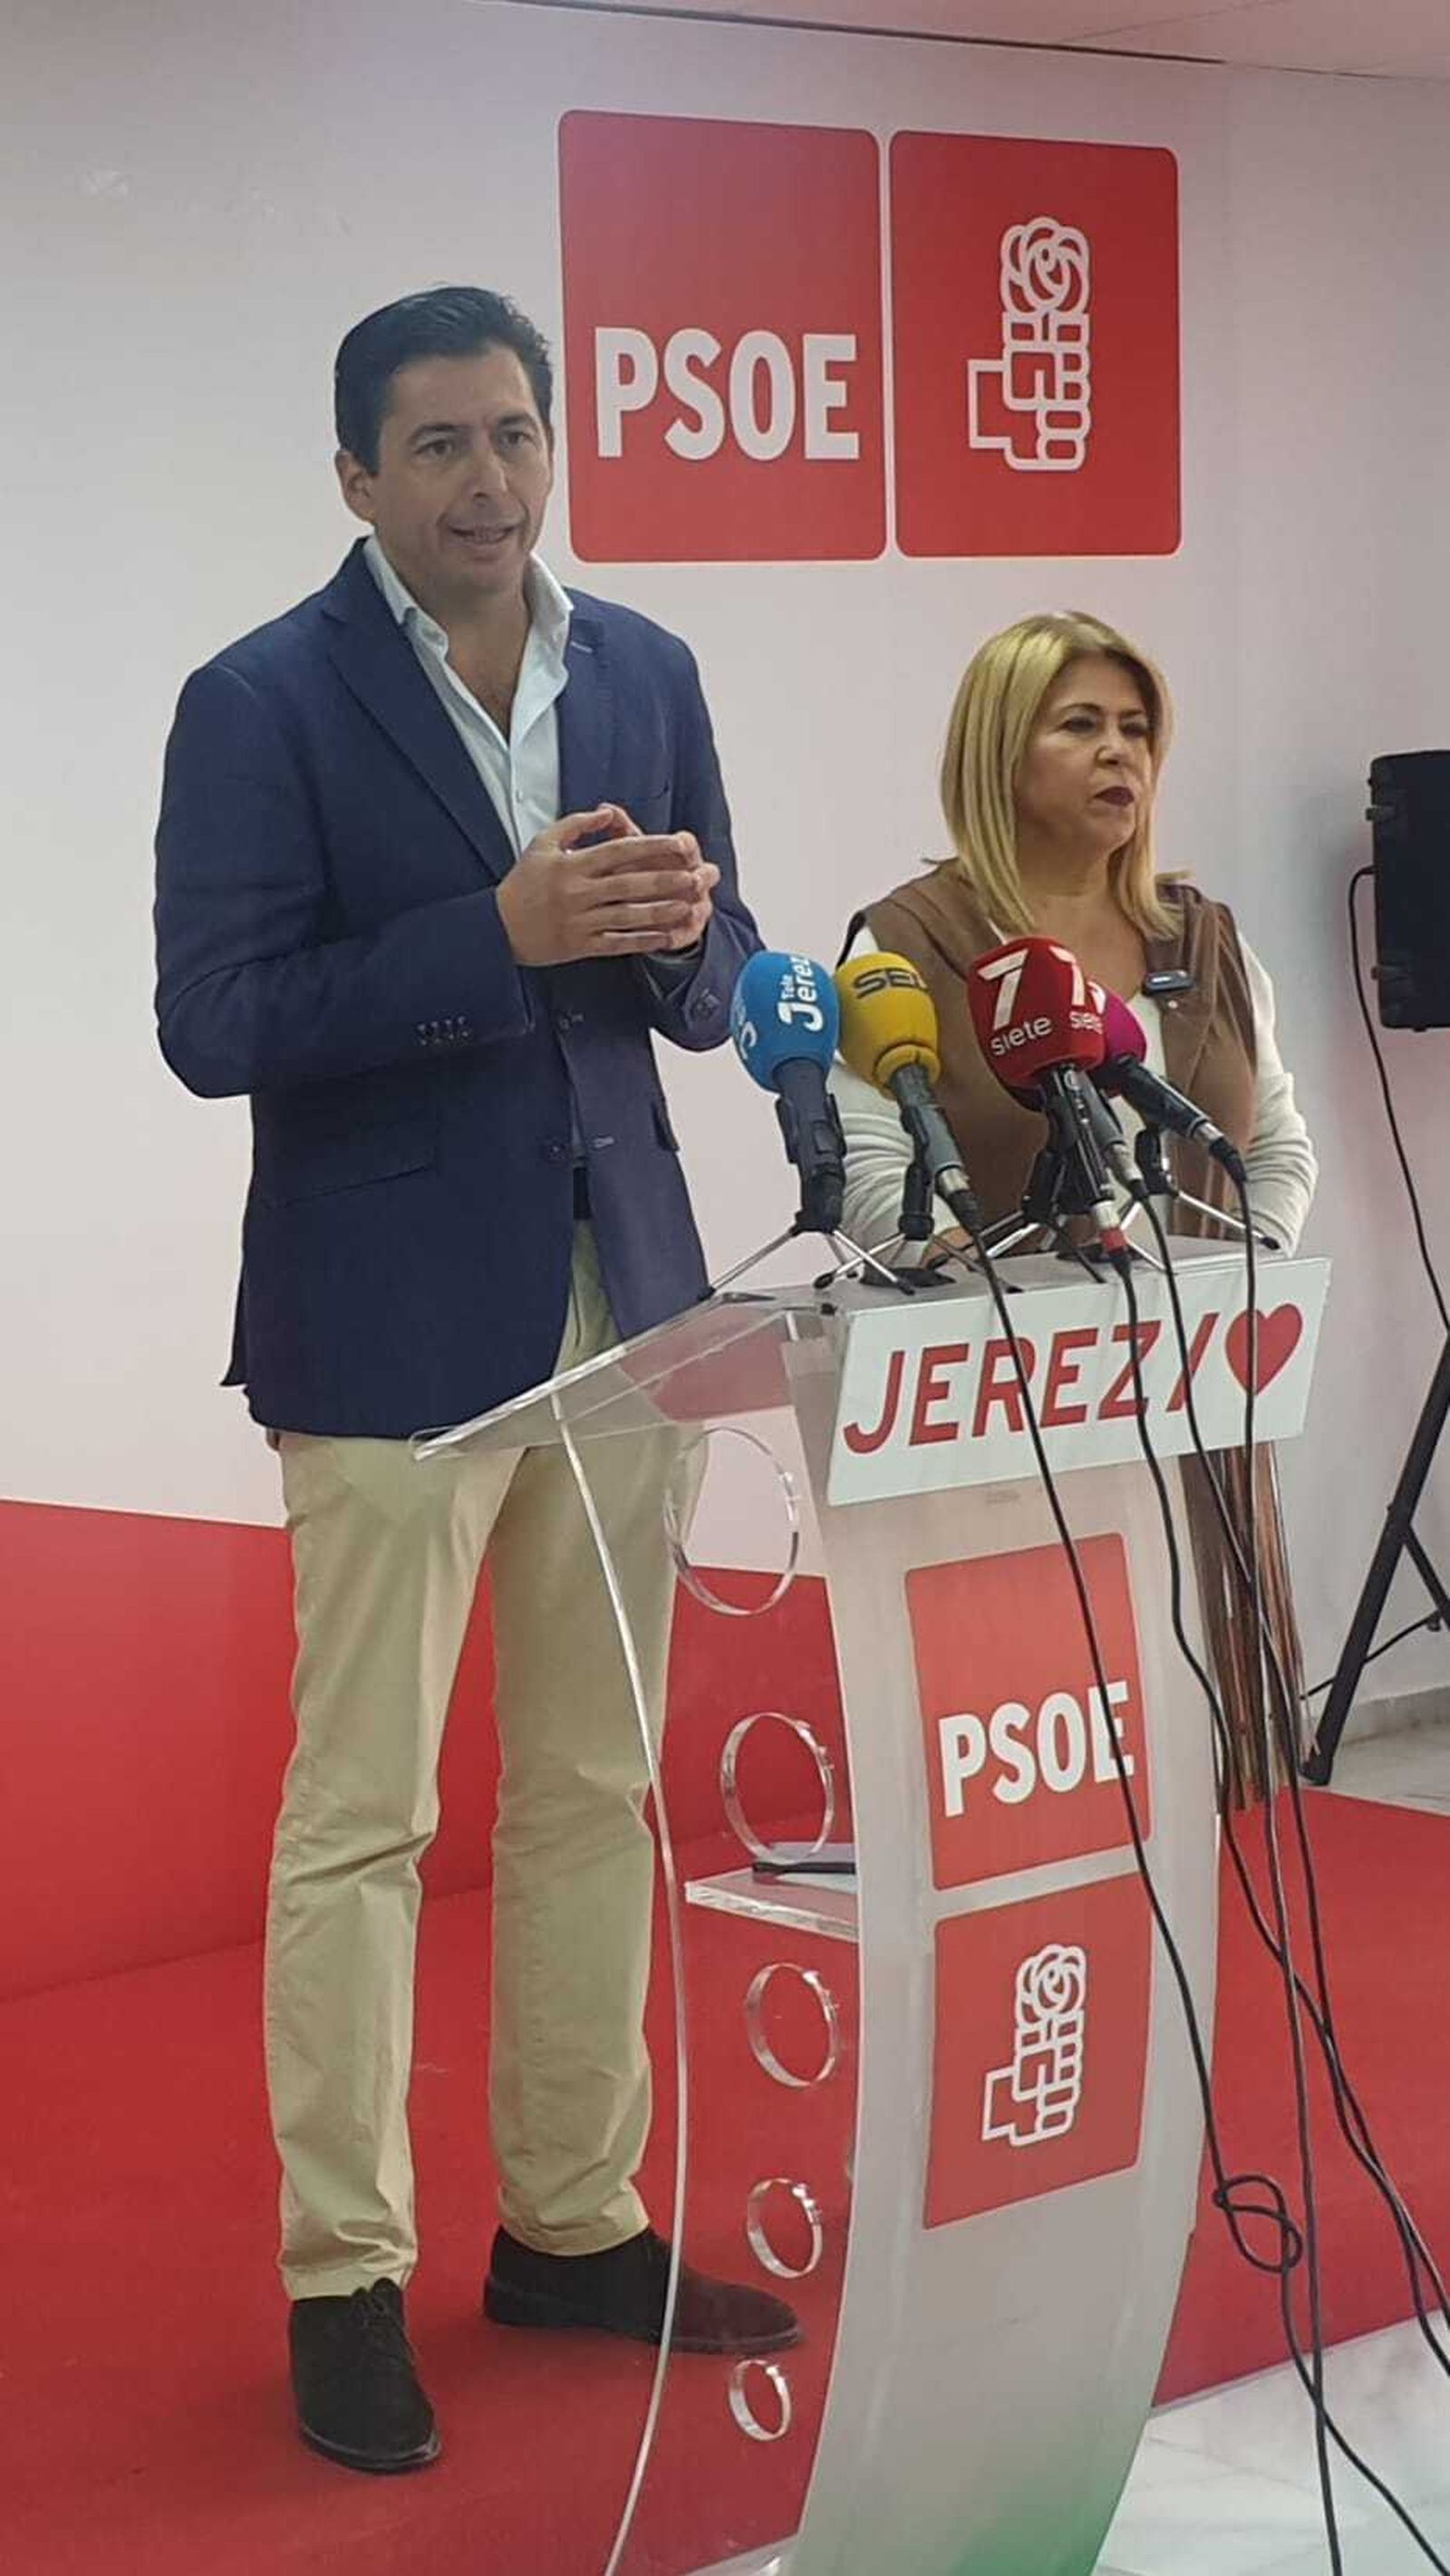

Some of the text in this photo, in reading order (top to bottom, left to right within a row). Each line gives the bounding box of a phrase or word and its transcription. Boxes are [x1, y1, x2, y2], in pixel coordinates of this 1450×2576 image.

[594, 327, 860, 460] PSOE
[991, 1017, 1053, 1056] siete
[938, 1681, 1135, 1817] PSOE
